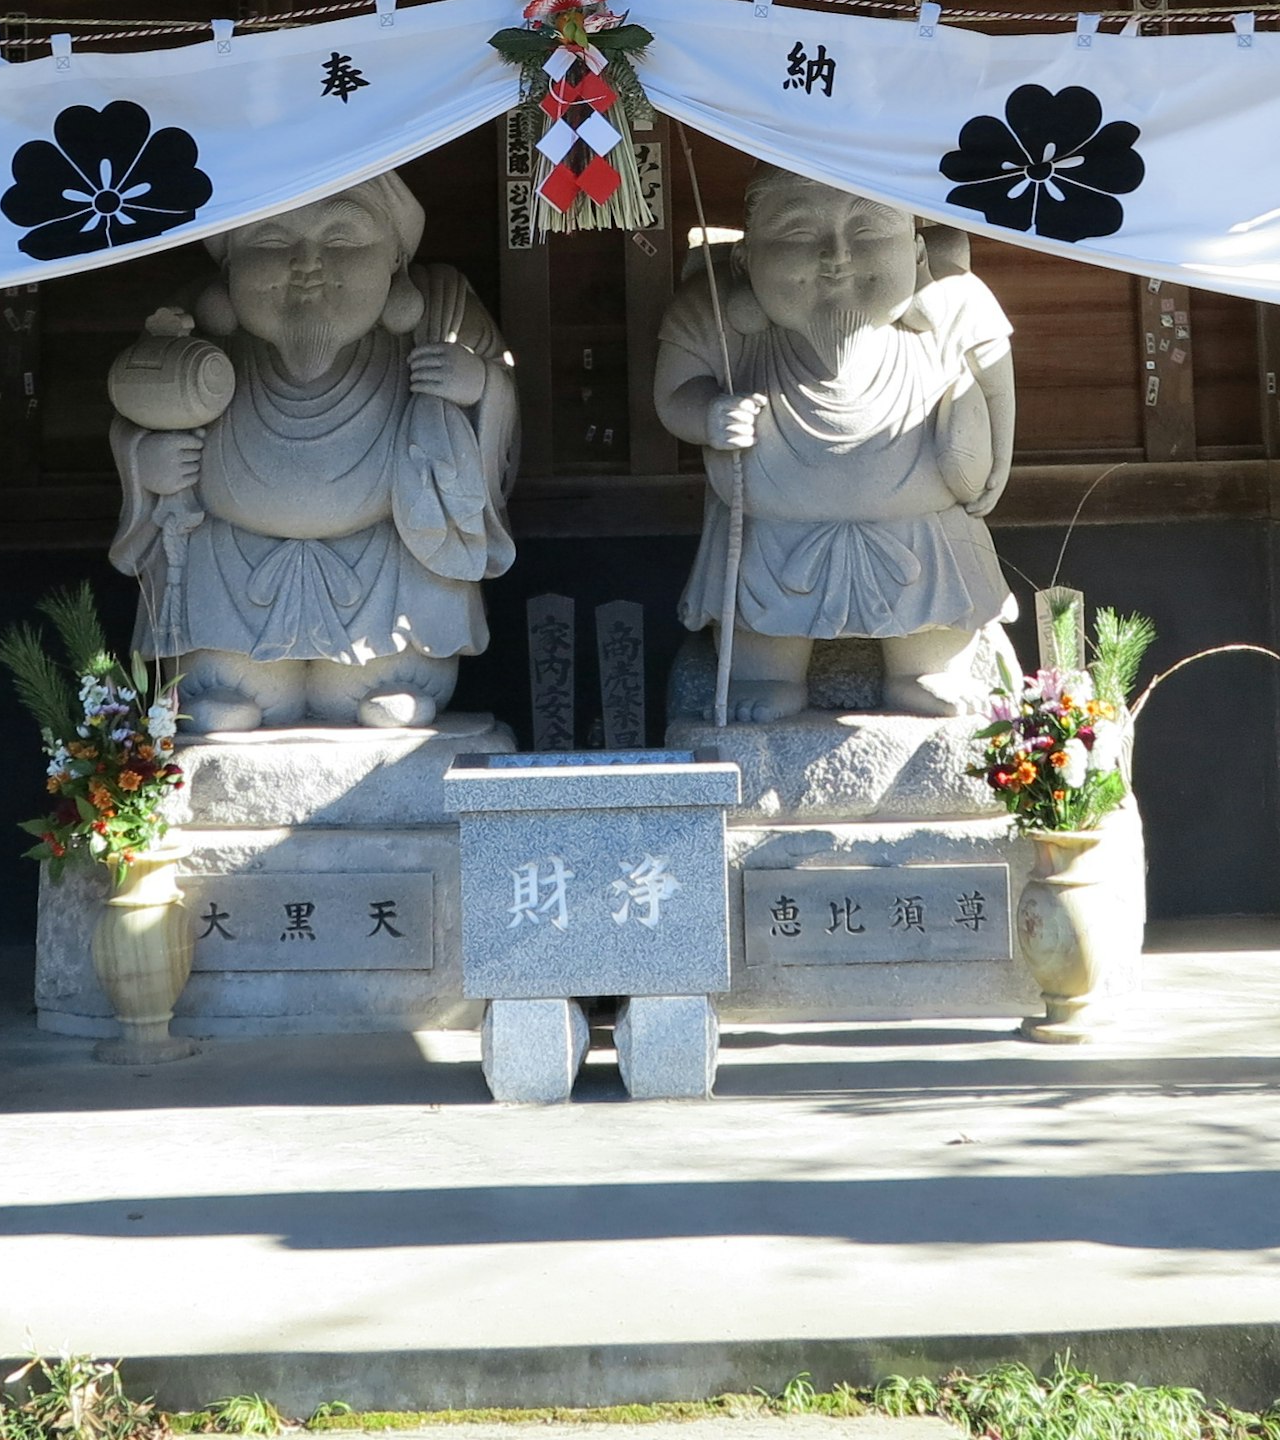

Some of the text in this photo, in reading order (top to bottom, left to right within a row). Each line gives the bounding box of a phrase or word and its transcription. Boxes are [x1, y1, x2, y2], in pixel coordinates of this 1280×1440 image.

[531, 615, 573, 751] 家内安全
[199, 899, 404, 941] 大黒天
[770, 890, 988, 937] 恵比須尊
